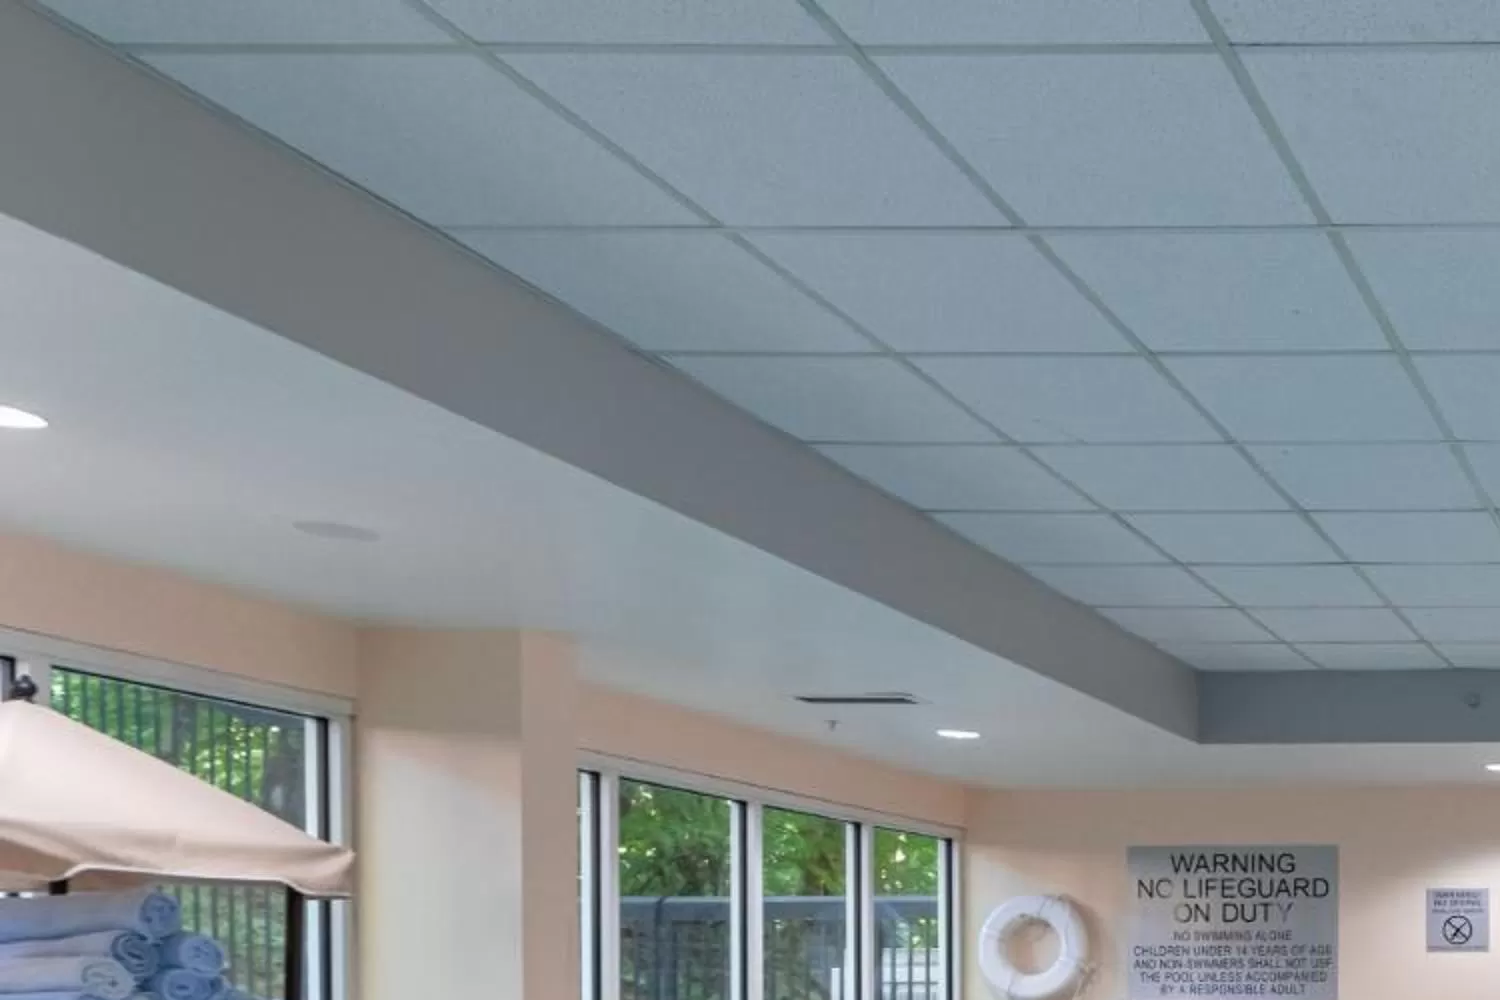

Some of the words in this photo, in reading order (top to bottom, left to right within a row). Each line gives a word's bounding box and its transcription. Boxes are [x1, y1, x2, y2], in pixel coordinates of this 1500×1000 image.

[1170, 853, 1296, 874] WARNING
[1136, 878, 1174, 899] NO
[1183, 877, 1330, 899] LIFEGUARD
[1174, 902, 1211, 923] ON
[1222, 902, 1294, 923] DUTY
[1133, 945, 1190, 956] CHILDREN
[1193, 945, 1232, 956] UNDER
